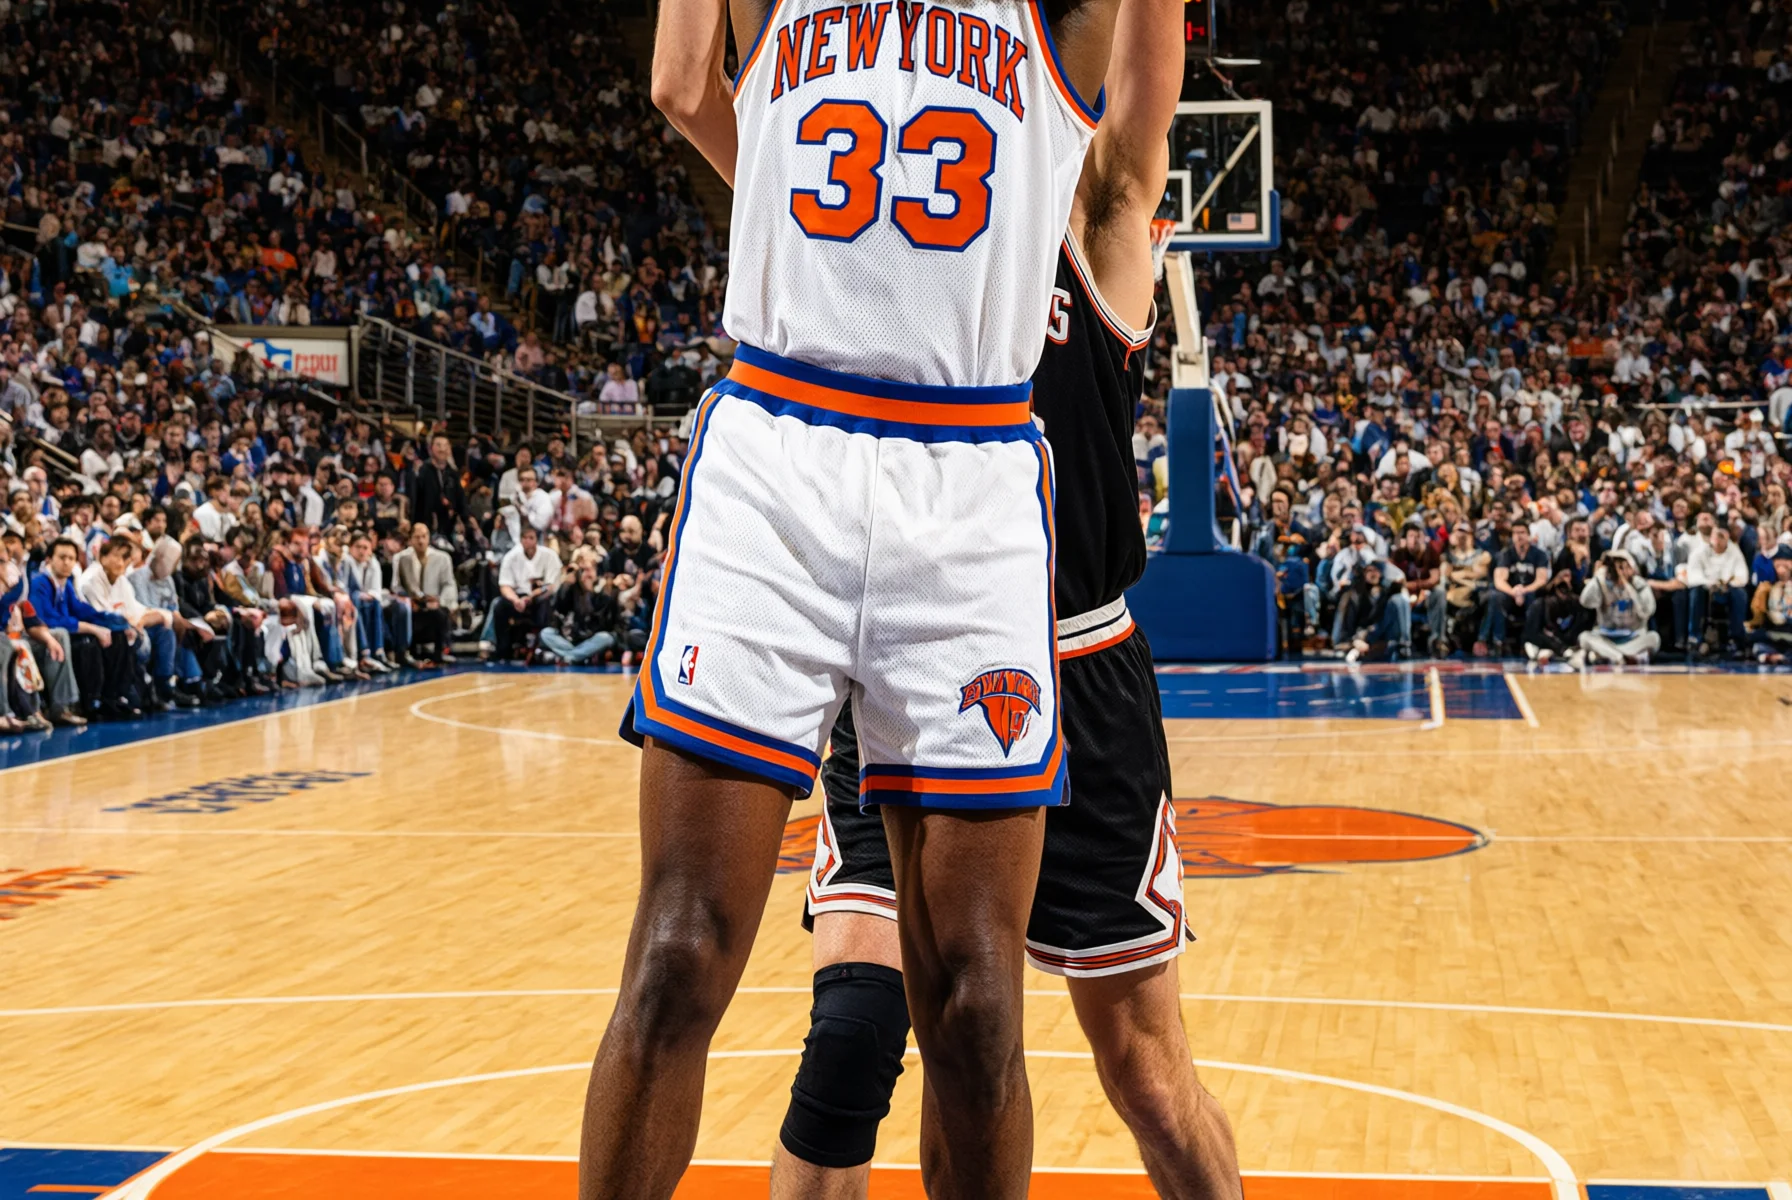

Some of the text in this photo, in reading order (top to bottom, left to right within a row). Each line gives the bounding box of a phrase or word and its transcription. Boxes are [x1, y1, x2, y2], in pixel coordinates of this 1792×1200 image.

[771, 0, 1028, 123] NEW YORK
[789, 98, 998, 253] 33
